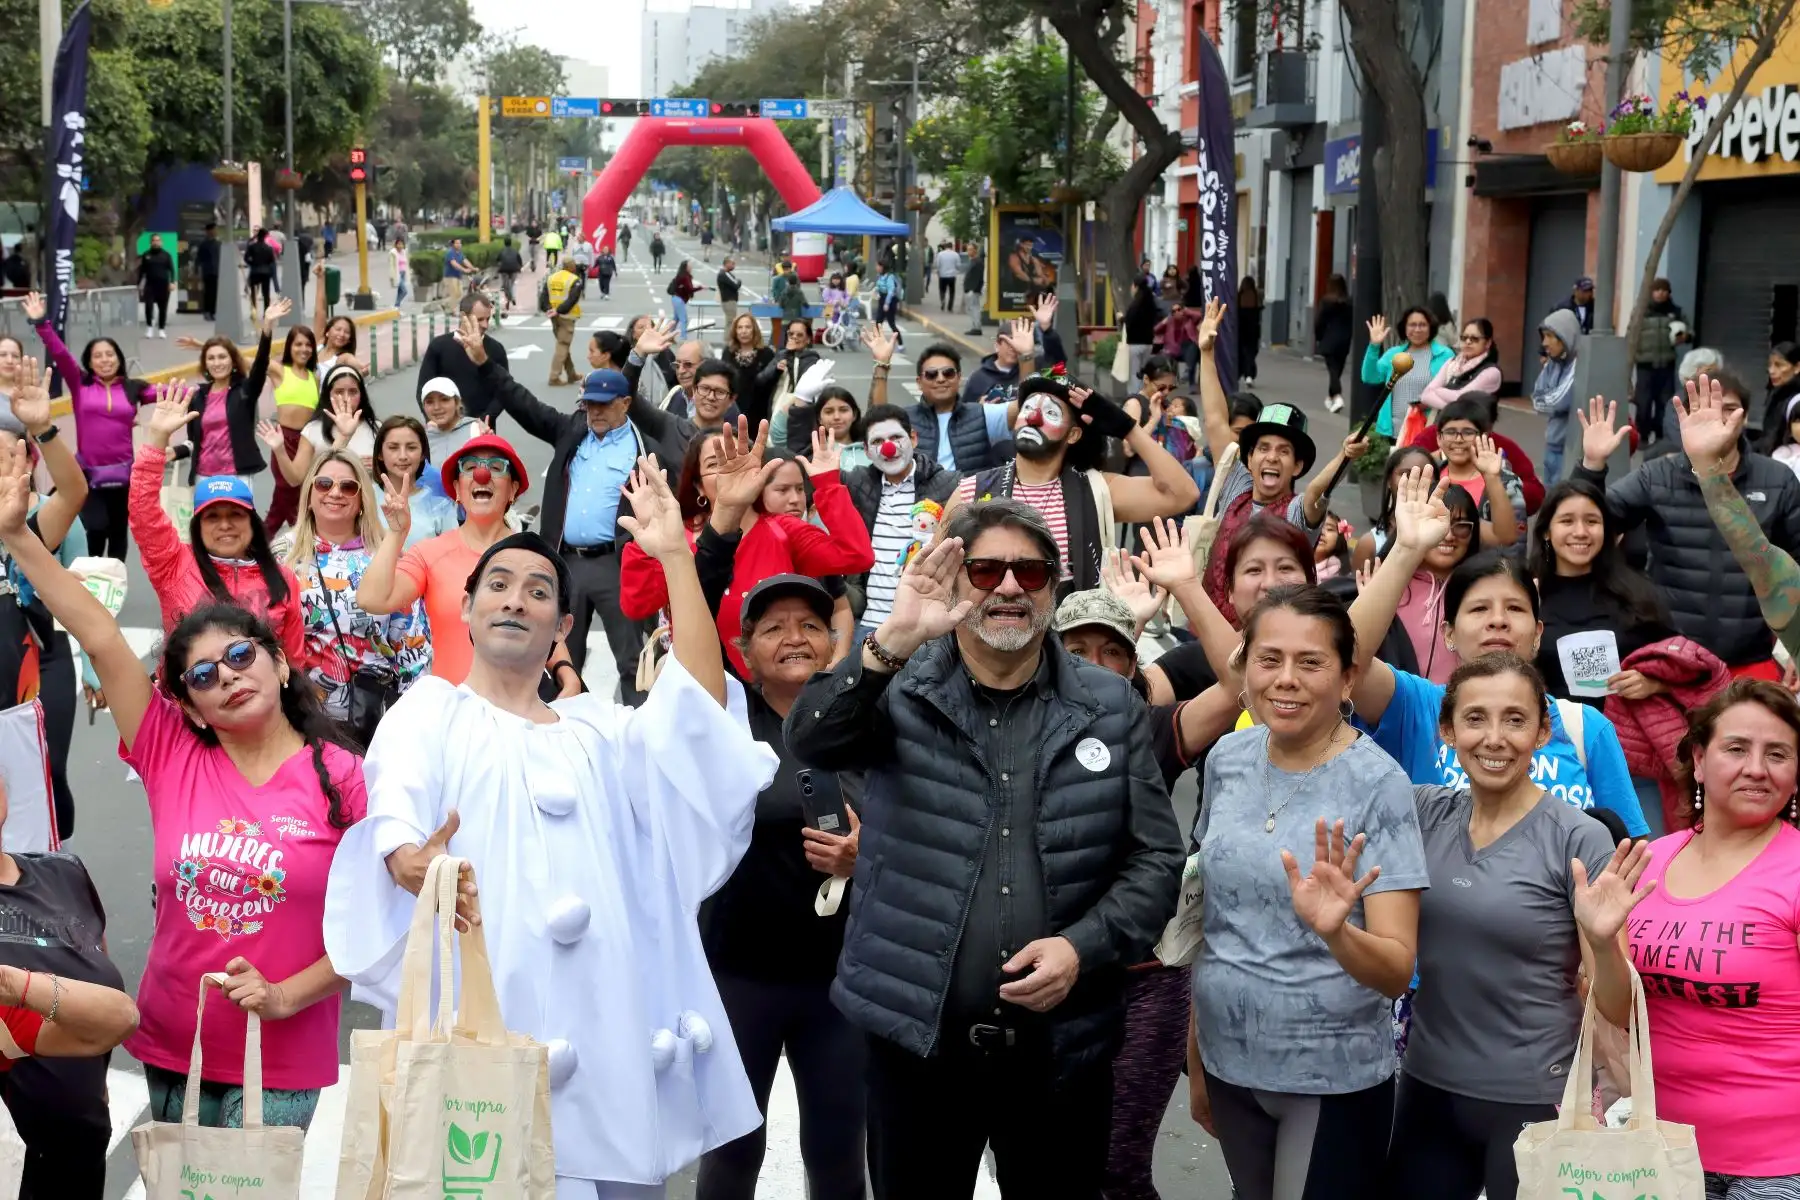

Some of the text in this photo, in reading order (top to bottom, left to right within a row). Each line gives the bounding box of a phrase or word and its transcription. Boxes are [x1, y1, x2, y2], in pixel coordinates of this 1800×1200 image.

[270, 814, 309, 828] Sentirse
[288, 822, 316, 837] Bien
[180, 831, 285, 876] MUJERES
[209, 868, 241, 893] QUE
[175, 878, 276, 920] Florecen
[1657, 920, 1687, 940] IN
[1700, 921, 1756, 946] THE
[1629, 943, 1727, 976] OMENT
[180, 1163, 217, 1190] Mejor
[1558, 1162, 1658, 1190] Mejor compra
